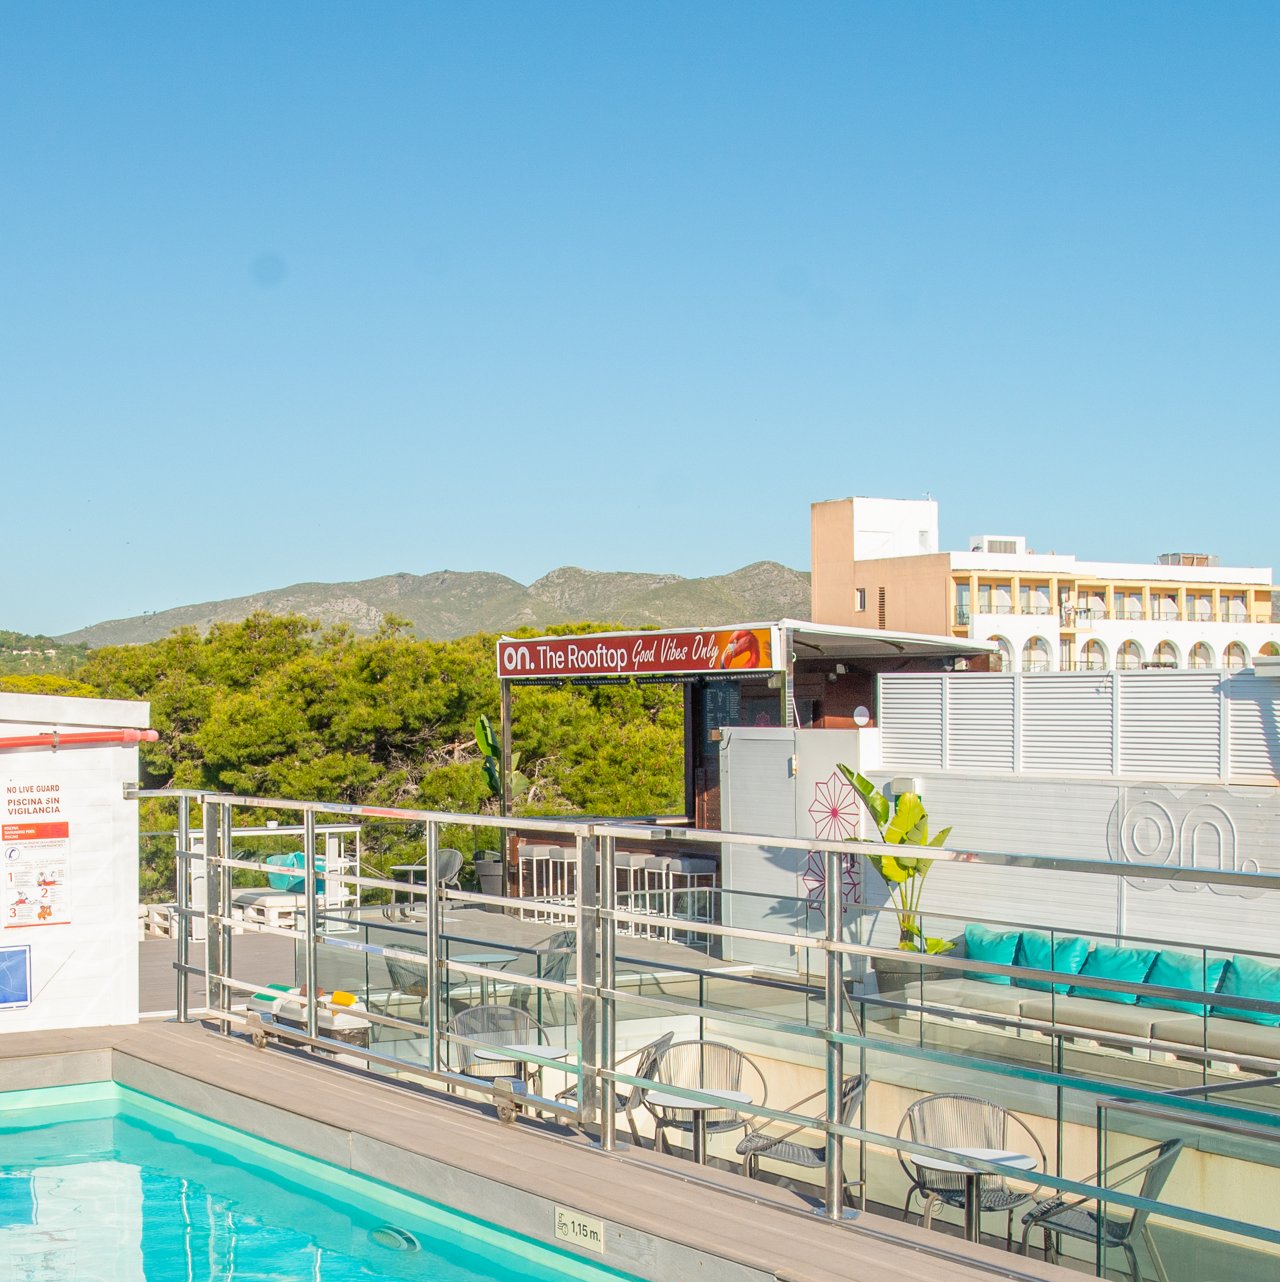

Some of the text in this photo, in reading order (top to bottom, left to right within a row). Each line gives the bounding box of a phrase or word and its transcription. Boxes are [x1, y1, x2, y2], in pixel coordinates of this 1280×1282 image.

[503, 633, 720, 672] on. The Rooftop Good Vibes Only
[6, 784, 60, 794] NO LIVE GUARD
[7, 797, 60, 807] PISCINA SIN
[7, 806, 61, 815] VIGILANCIA
[8, 872, 13, 882] 1
[41, 888, 48, 898] 2
[9, 908, 17, 918] 3
[570, 1220, 601, 1242] 1,15 m.
